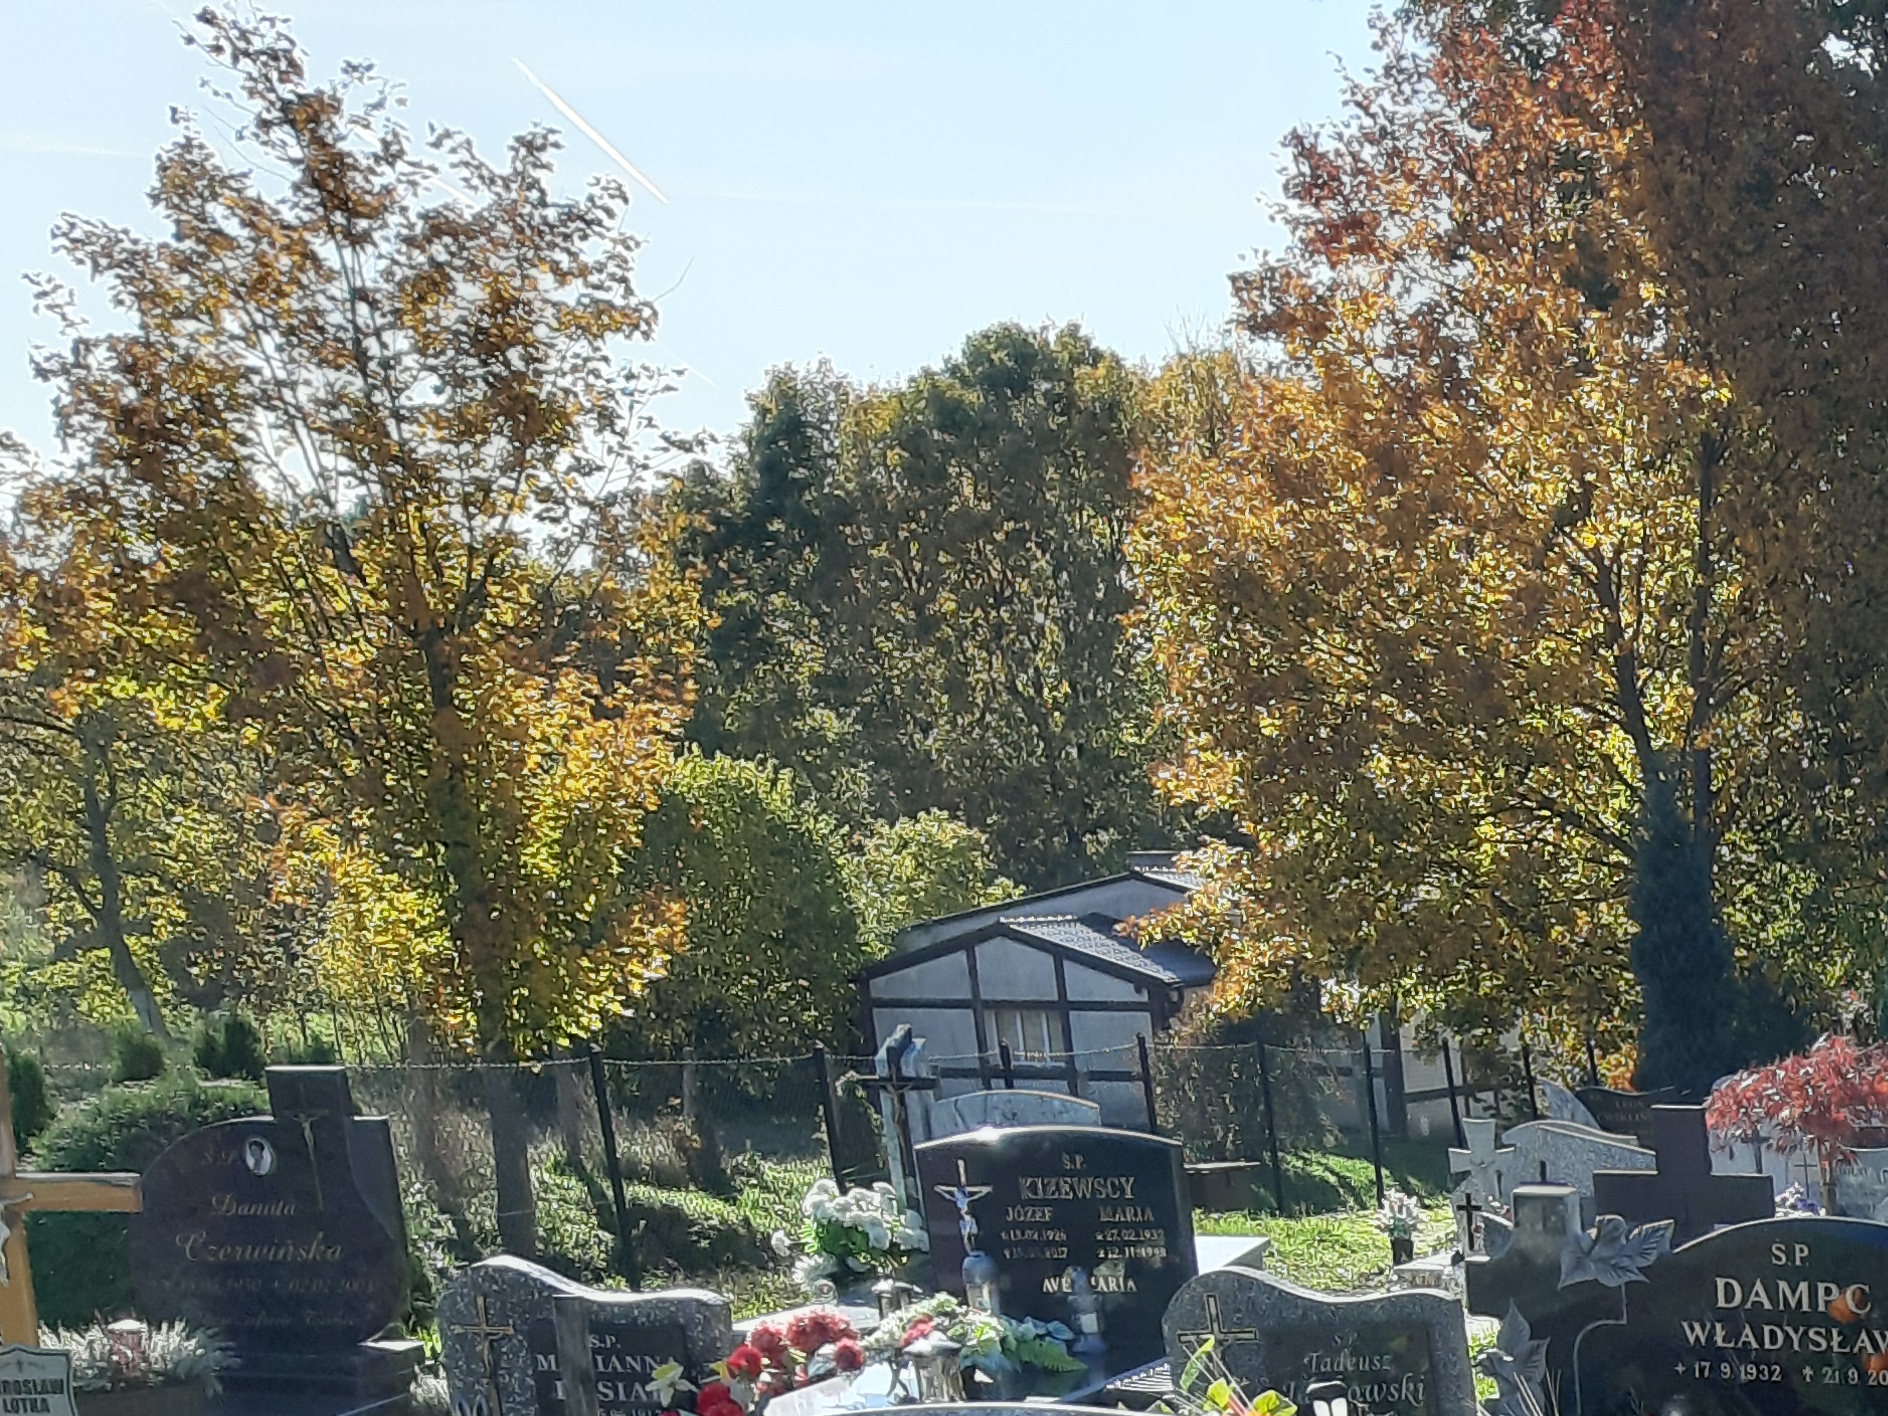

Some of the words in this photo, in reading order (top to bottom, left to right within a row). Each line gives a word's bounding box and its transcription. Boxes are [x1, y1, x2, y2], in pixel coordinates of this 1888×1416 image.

[210, 1193, 296, 1216] Danuta
[1005, 1204, 1053, 1222] JÓZEF
[1100, 1206, 1154, 1222] MARIA
[175, 1231, 343, 1262] Czerwińska
[1715, 1277, 1872, 1315] DAMPC
[1303, 1348, 1391, 1373] Tadeusz
